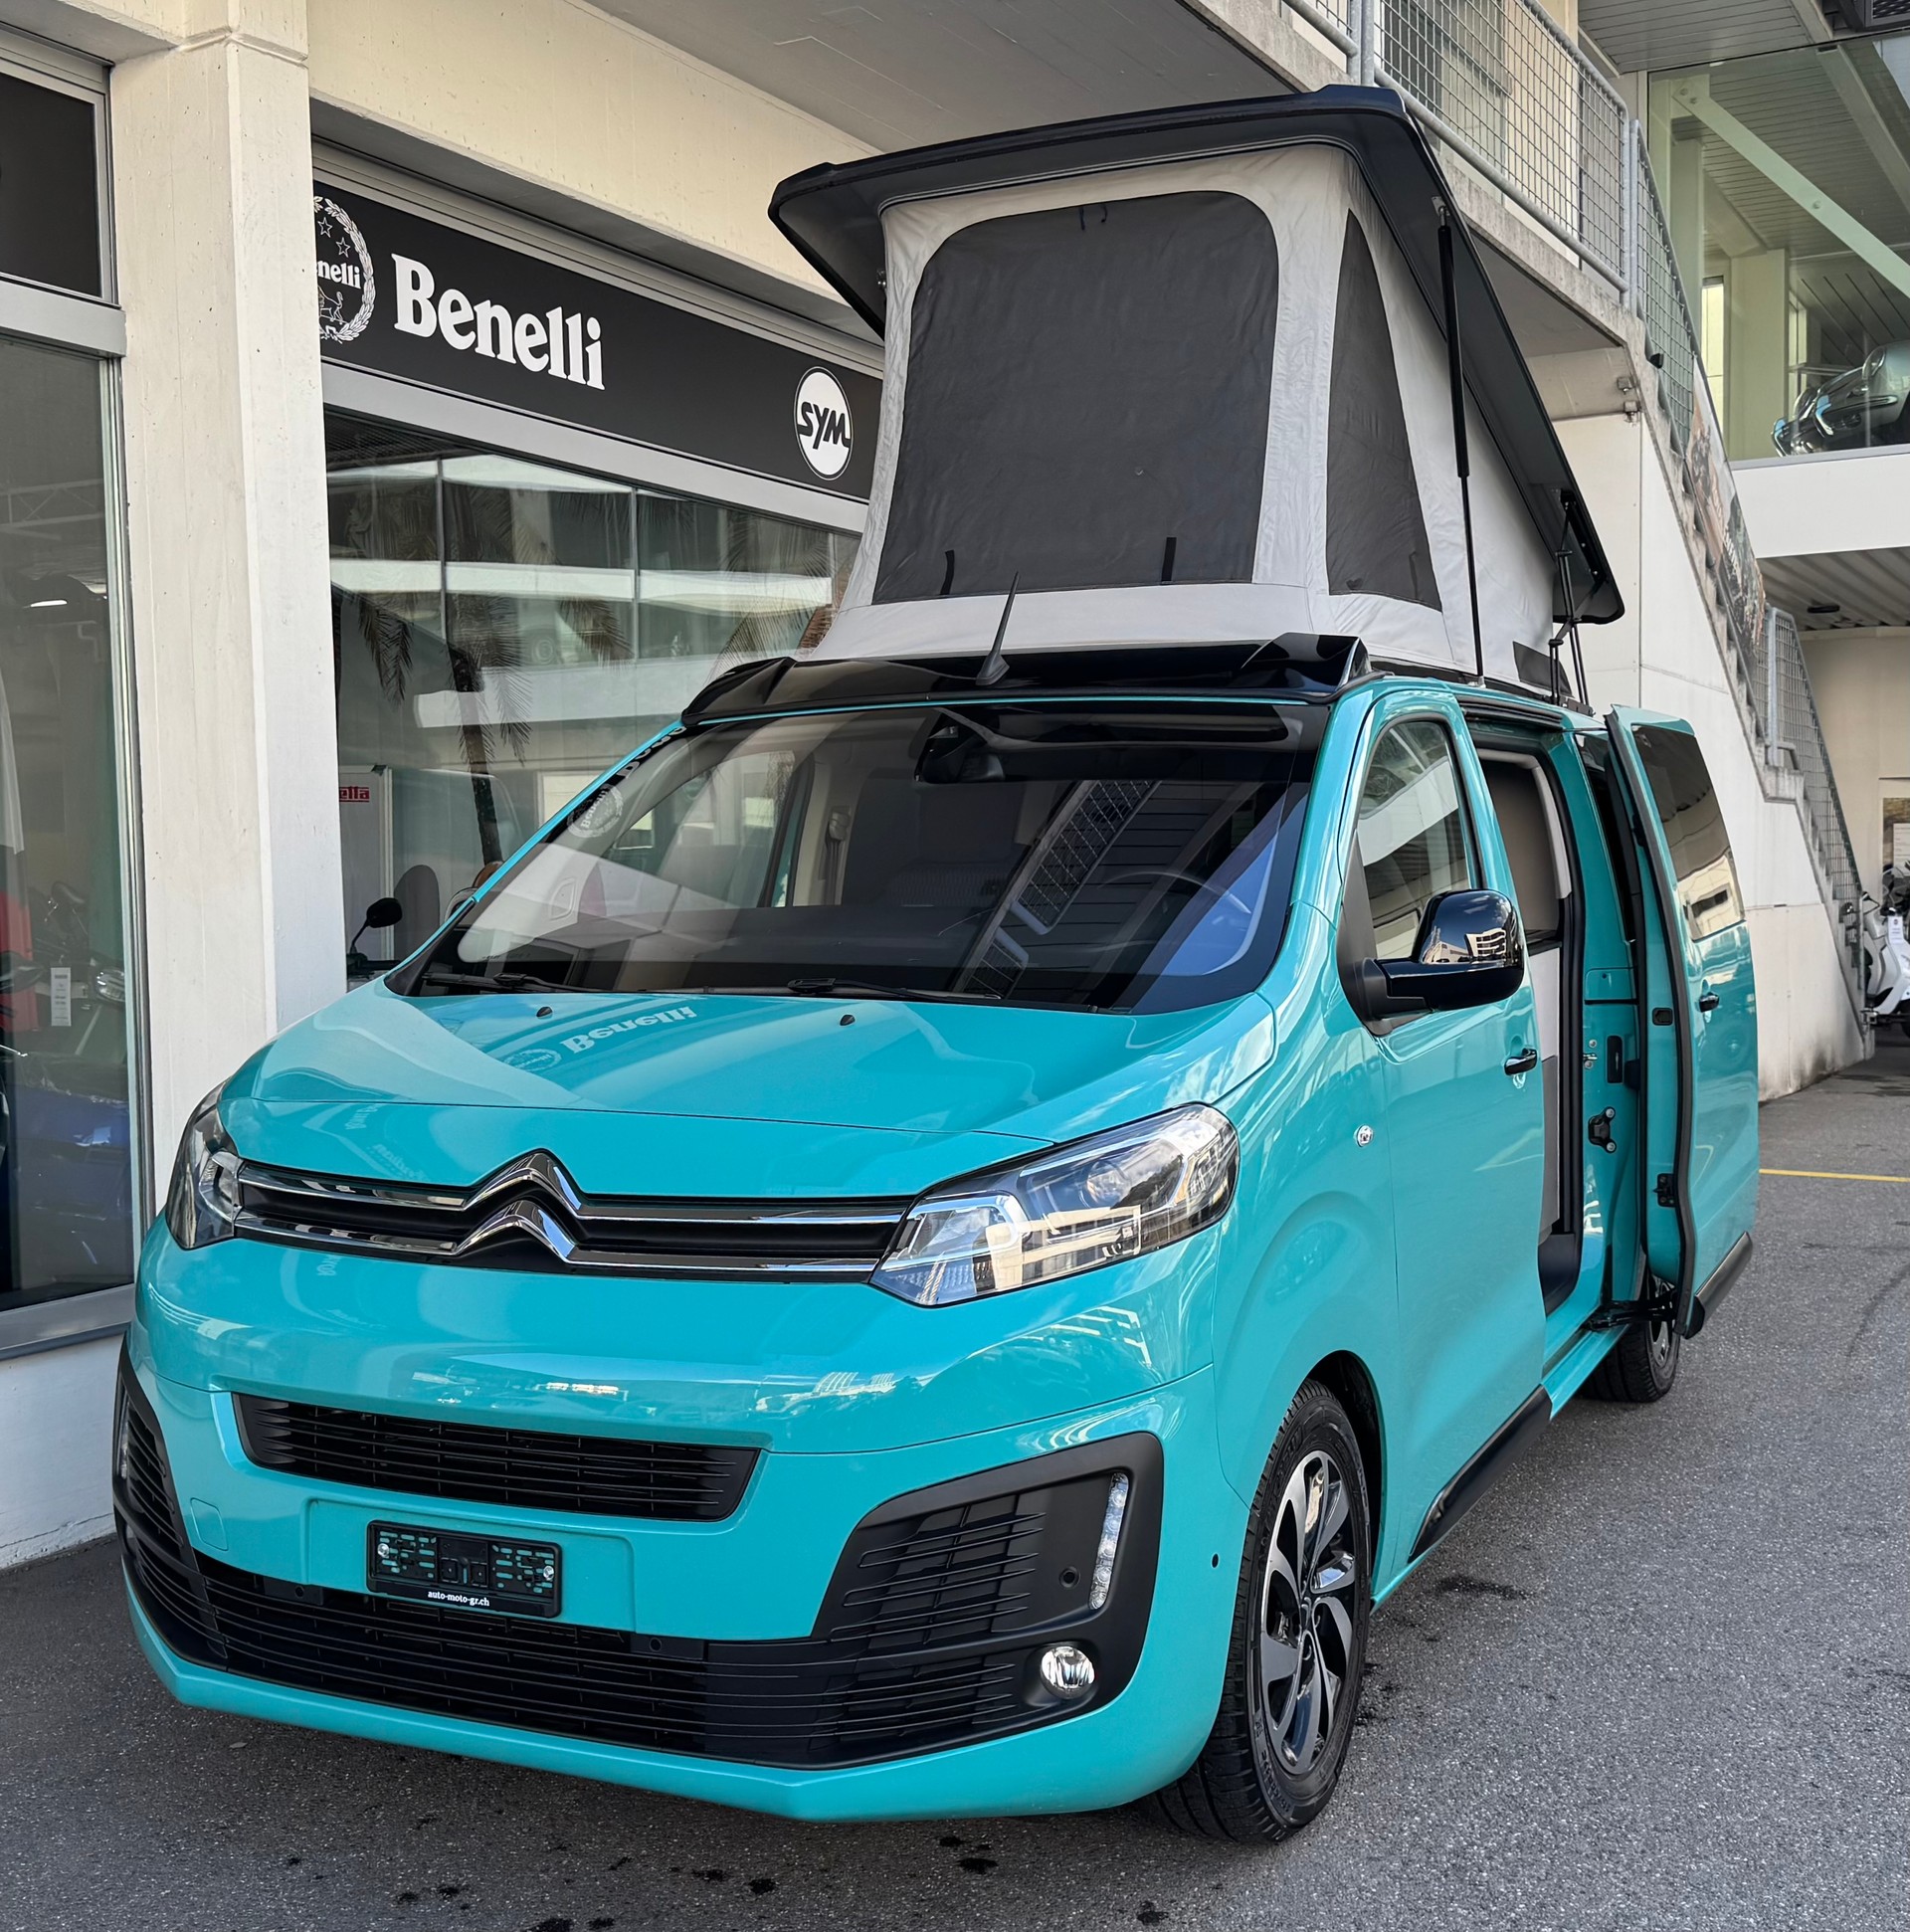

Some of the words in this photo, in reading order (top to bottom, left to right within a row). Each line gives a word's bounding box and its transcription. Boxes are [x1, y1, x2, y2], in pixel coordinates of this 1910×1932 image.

[316, 261, 361, 289] nelli
[391, 253, 605, 390] Benelli
[797, 401, 852, 450] SYM
[427, 1591, 490, 1607] auto-moto-gr.ch
